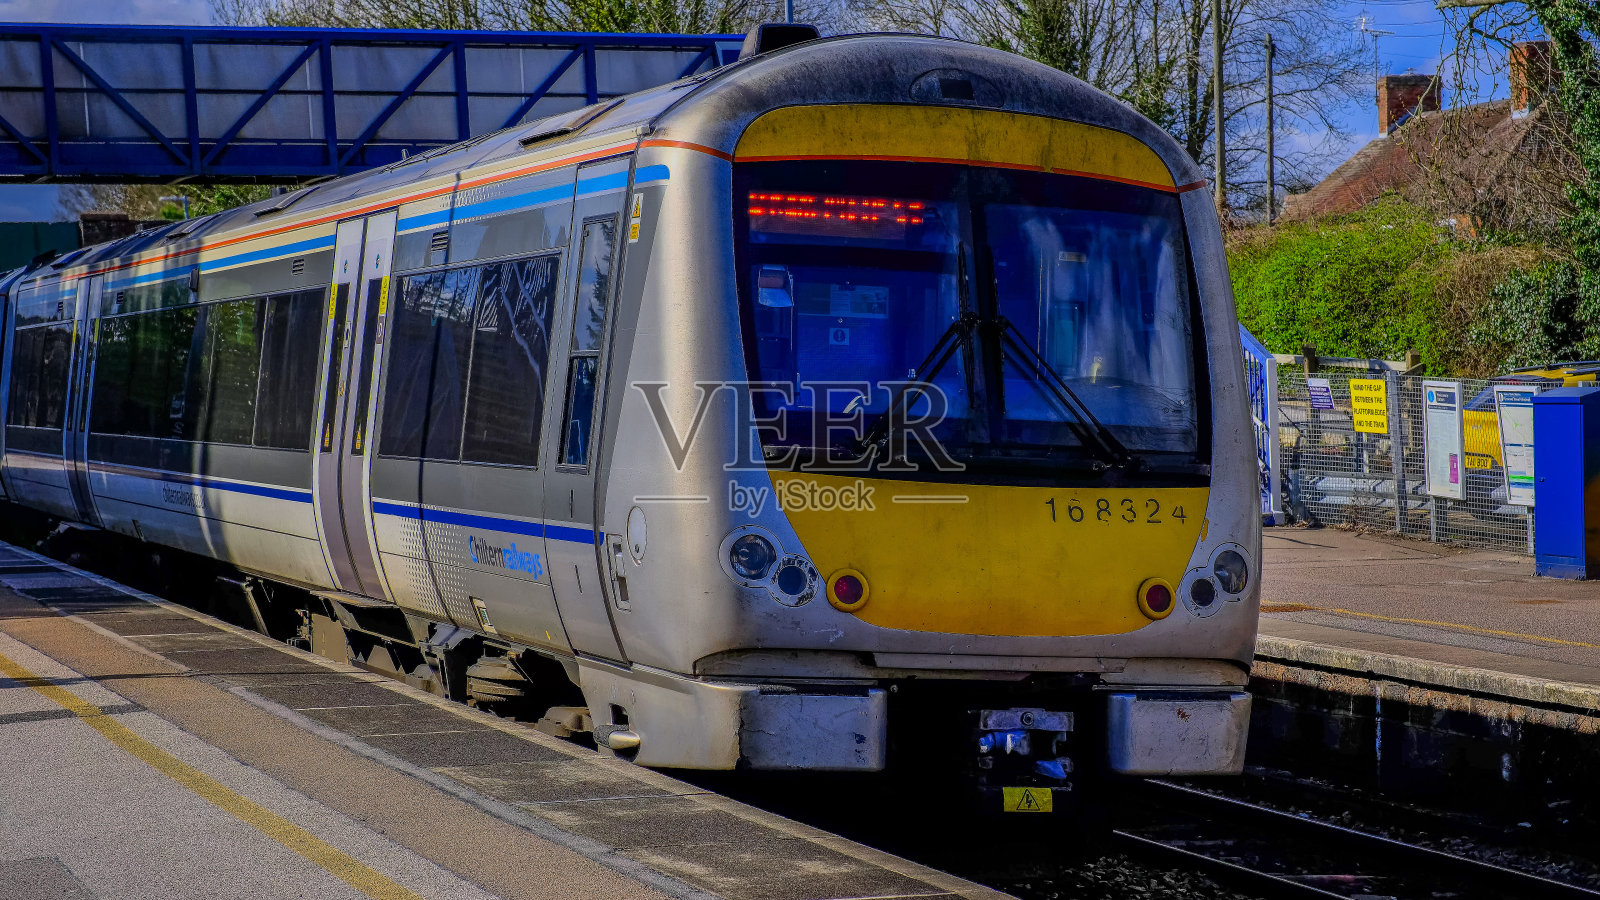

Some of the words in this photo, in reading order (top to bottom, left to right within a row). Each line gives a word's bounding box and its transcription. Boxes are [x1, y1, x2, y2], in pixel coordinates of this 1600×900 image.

[1354, 396, 1374, 404] BETWEEN
[1353, 408, 1374, 416] PLATFORM
[1045, 497, 1188, 525] 168324
